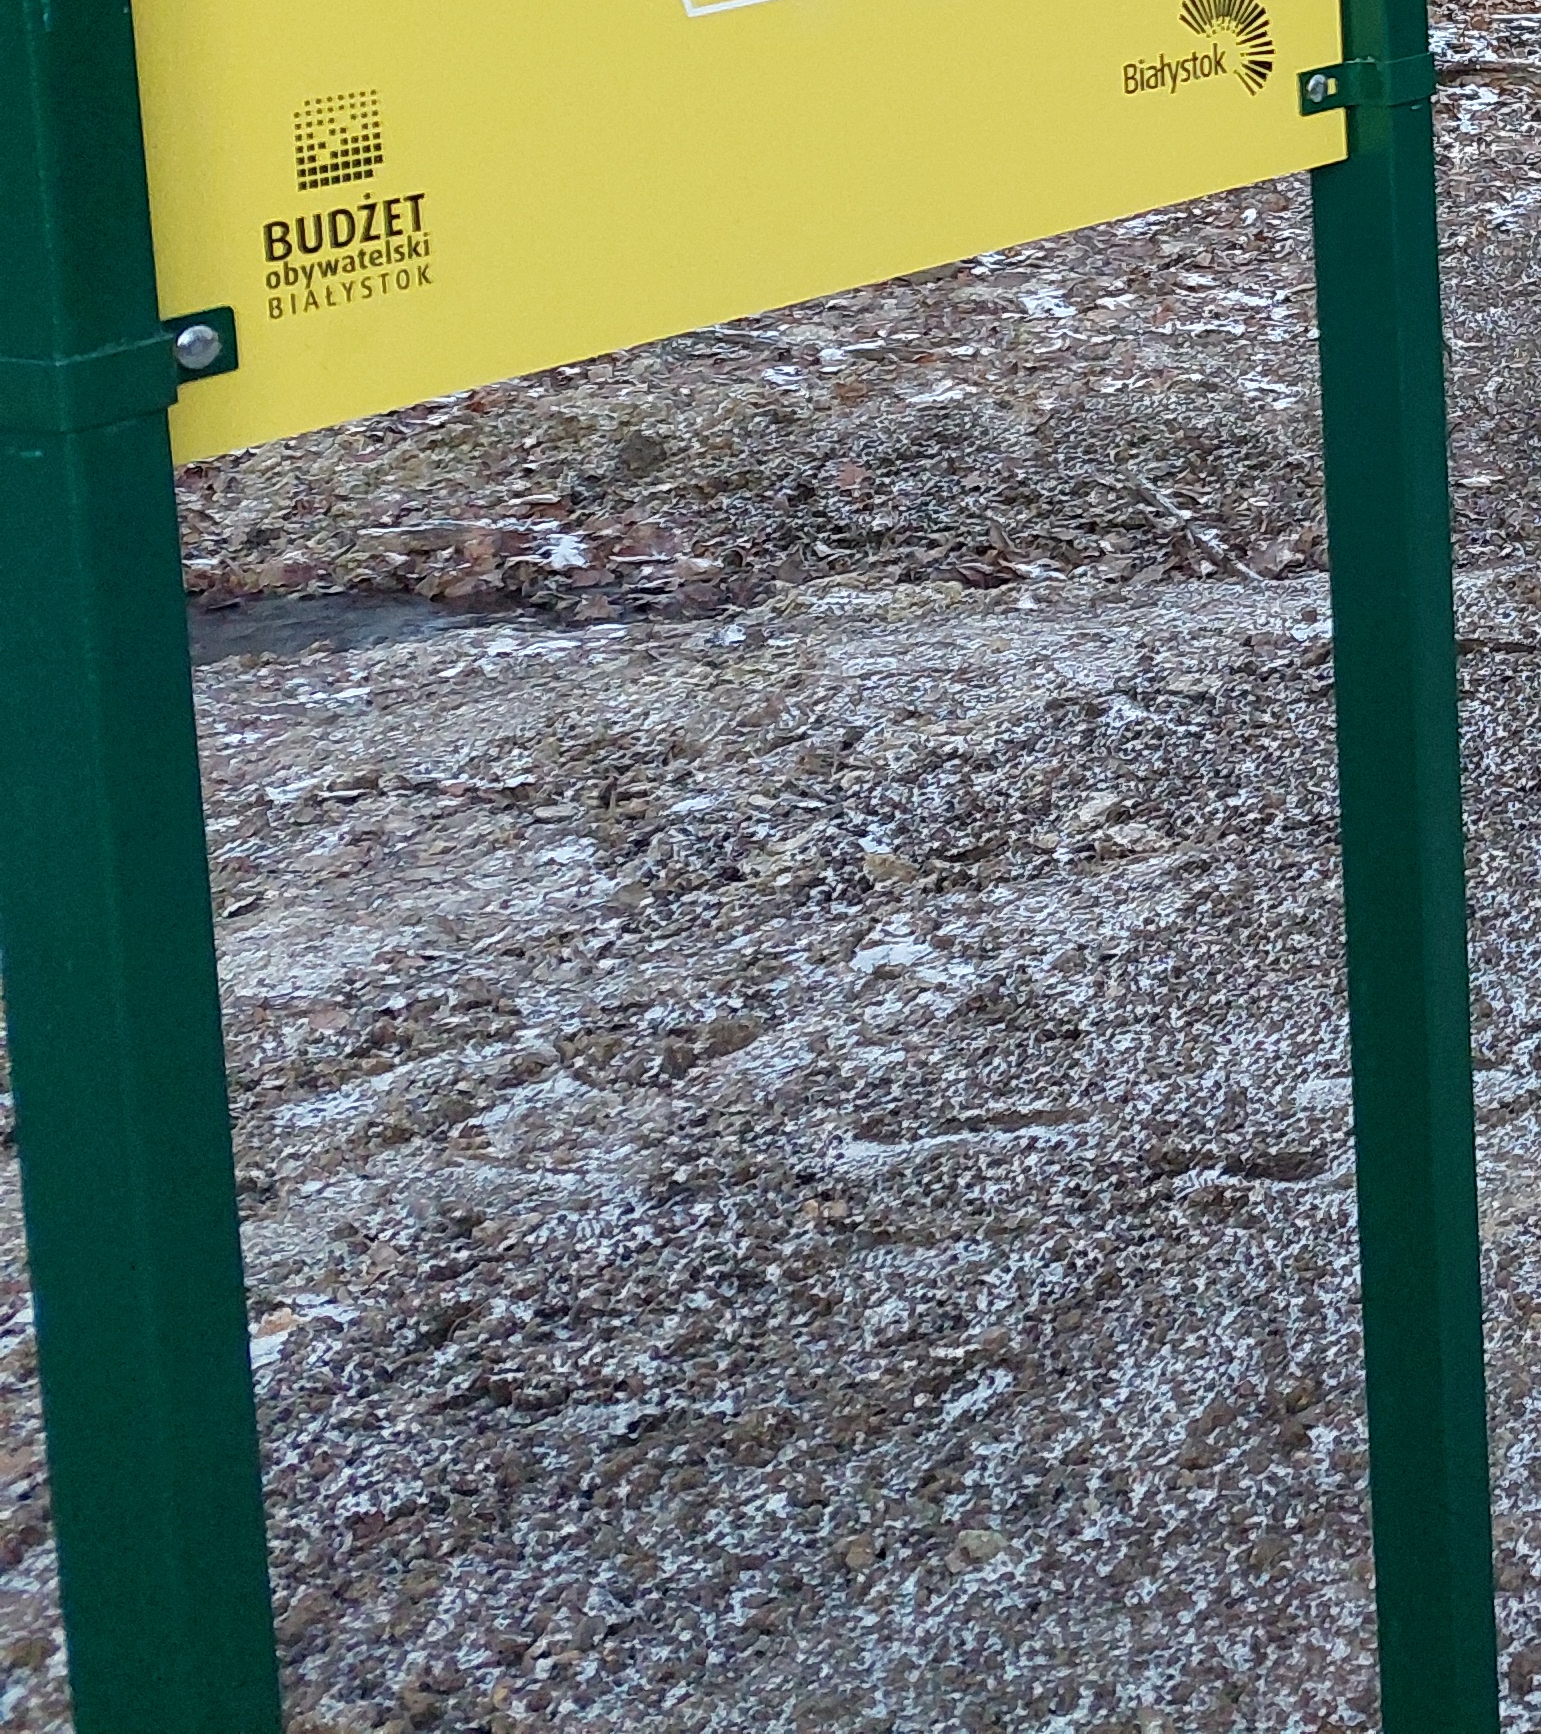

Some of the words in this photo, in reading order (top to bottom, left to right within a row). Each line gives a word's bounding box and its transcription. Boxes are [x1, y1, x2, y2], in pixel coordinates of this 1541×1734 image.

[1123, 42, 1227, 95] Białystok
[263, 191, 426, 262] BUDŻET
[265, 232, 430, 290] obywatelski
[268, 264, 433, 320] BIAŁYSTOK
